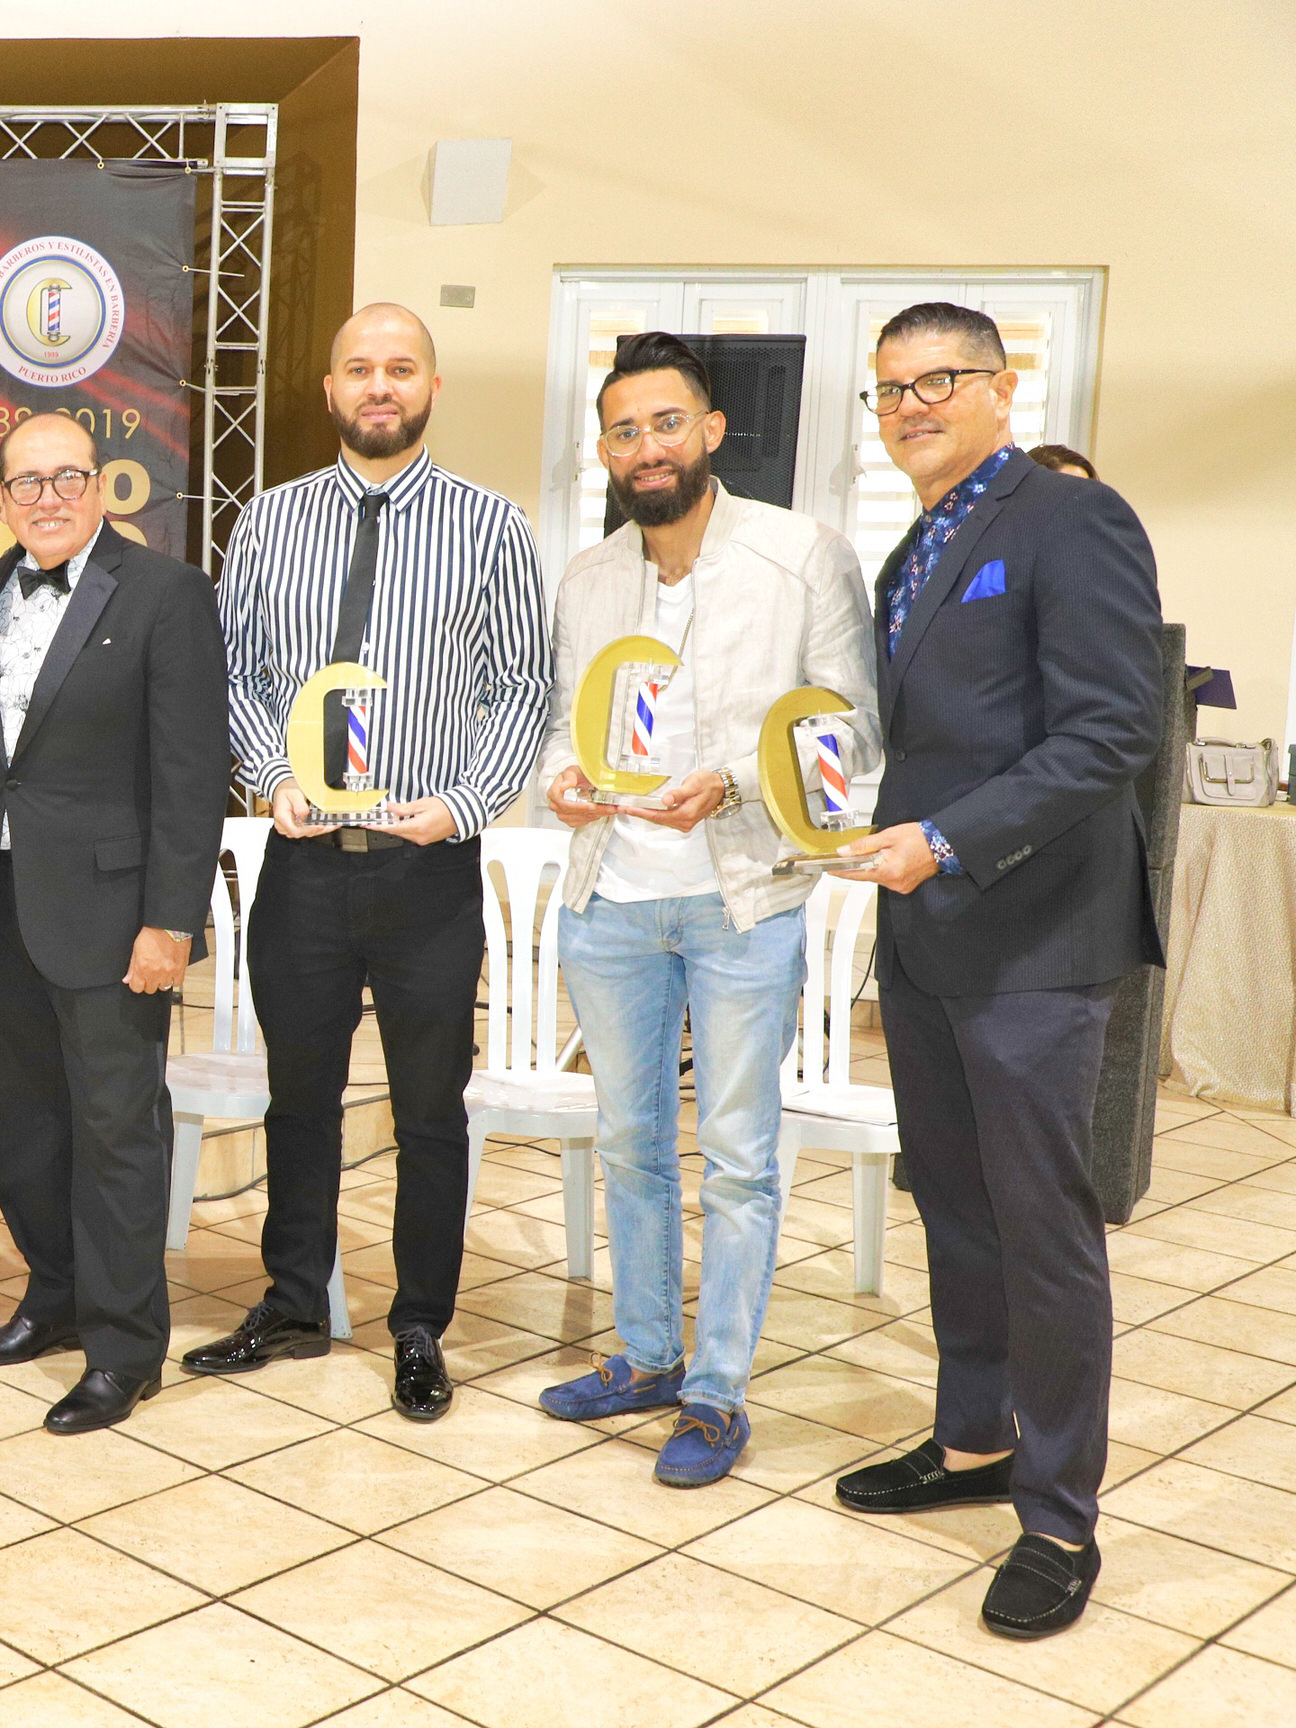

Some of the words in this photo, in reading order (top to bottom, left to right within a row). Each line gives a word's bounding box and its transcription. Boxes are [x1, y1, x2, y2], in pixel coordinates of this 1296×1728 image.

[48, 241, 55, 249] Y
[57, 241, 109, 278] ESTILISTAS
[105, 278, 117, 292] EN
[18, 365, 59, 383] PUERTO
[61, 366, 87, 382] RICO
